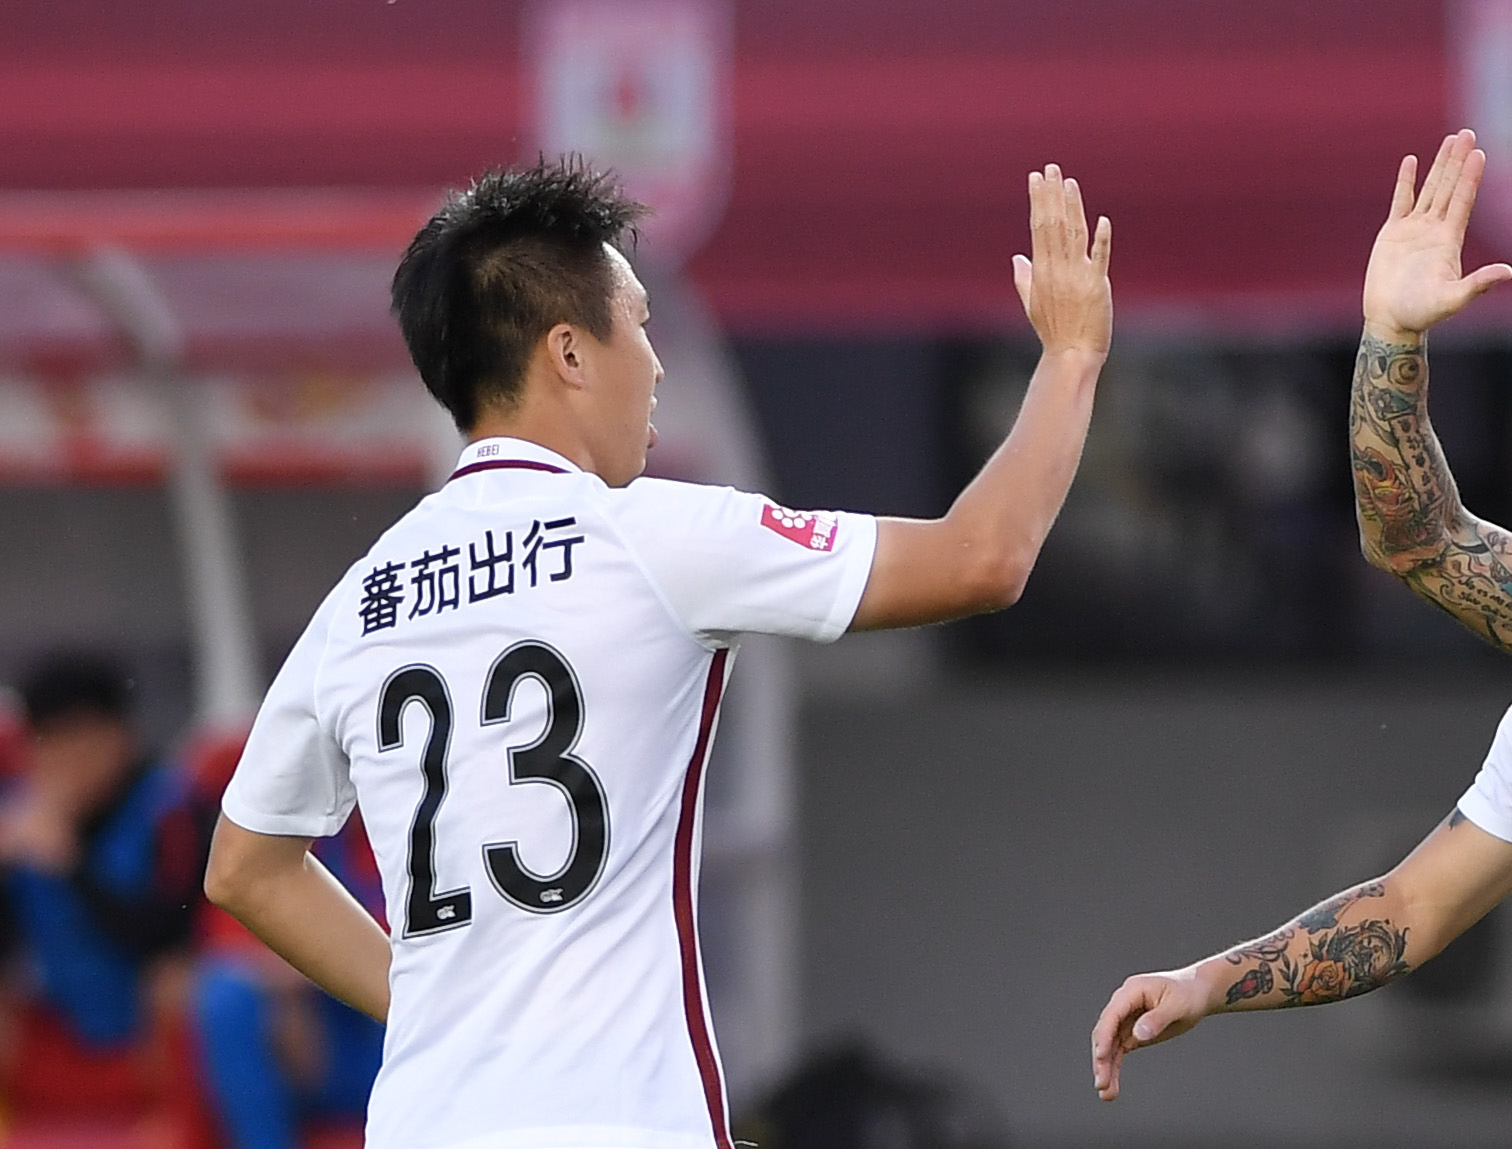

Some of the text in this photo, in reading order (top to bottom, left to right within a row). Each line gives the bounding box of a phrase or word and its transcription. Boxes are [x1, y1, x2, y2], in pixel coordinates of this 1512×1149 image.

[358, 516, 585, 638] 蕃茄出行
[376, 637, 612, 939] 23
